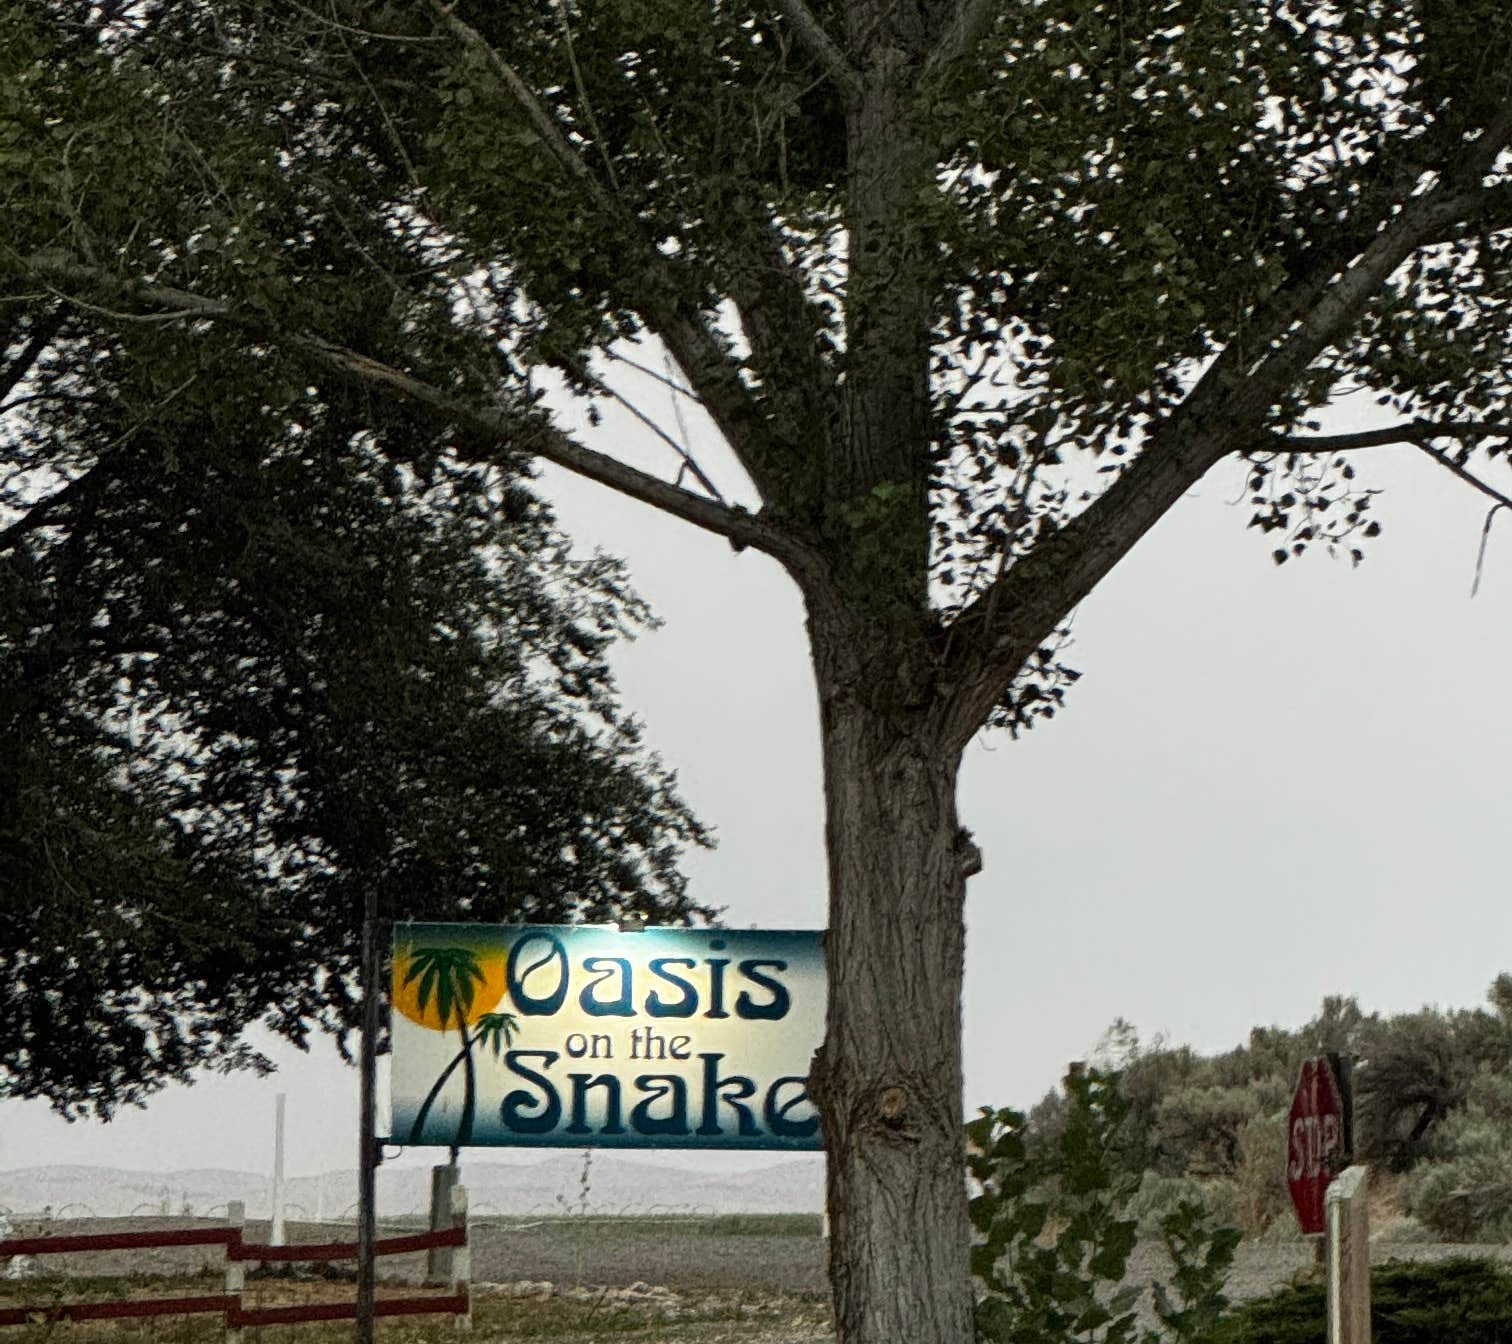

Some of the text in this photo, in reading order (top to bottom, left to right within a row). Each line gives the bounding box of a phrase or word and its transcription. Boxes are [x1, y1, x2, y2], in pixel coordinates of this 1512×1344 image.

[506, 932, 791, 1020] Oasis
[565, 1026, 692, 1060] on the
[501, 1050, 819, 1137] Snake
[1288, 1114, 1339, 1181] STOP
